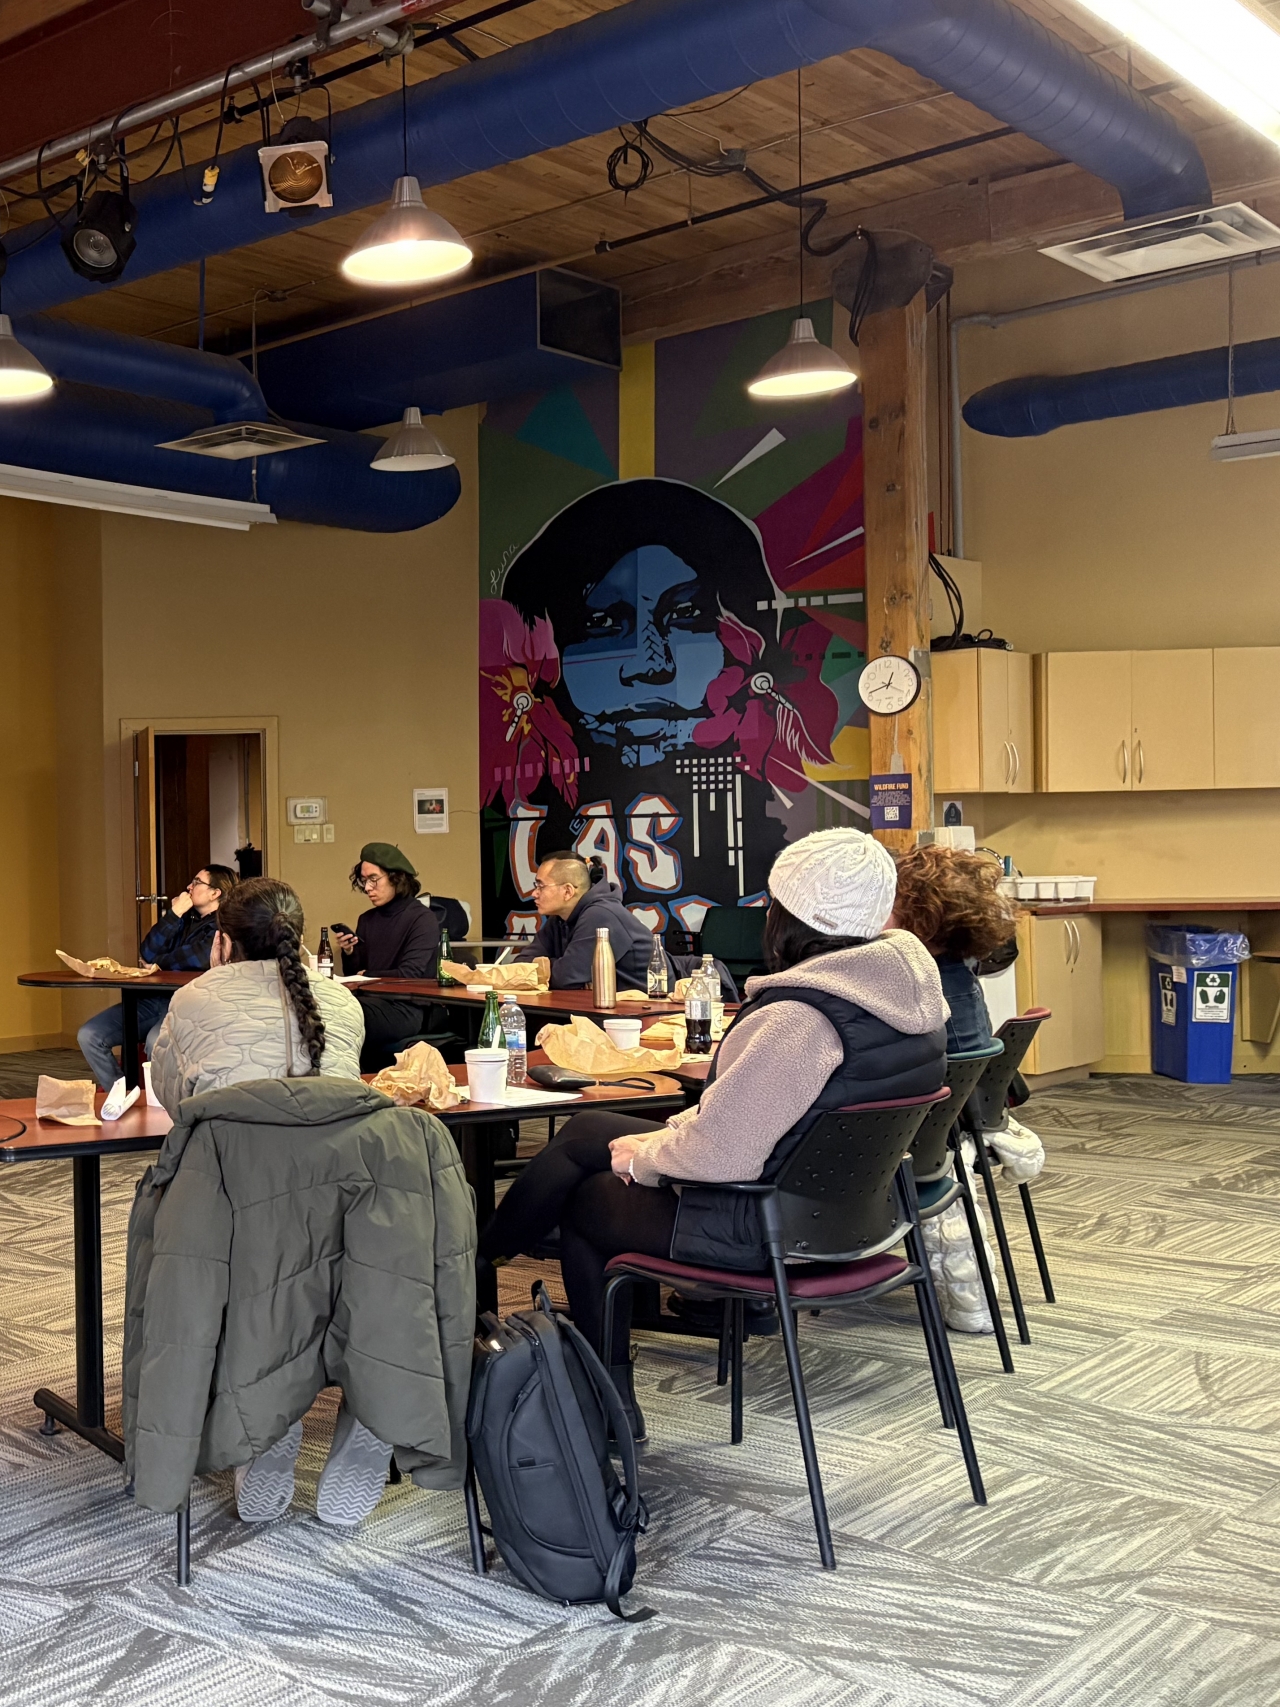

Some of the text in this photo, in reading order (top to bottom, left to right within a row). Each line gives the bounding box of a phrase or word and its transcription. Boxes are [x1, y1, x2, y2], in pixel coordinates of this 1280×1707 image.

[875, 664, 882, 672] 11
[884, 660, 892, 668] 12
[868, 672, 876, 680] 10
[904, 668, 910, 678] 2
[864, 682, 870, 690] 9
[876, 699, 882, 708] 7
[886, 701, 893, 710] 6
[898, 697, 904, 706] 5
[509, 792, 683, 902] LAS
